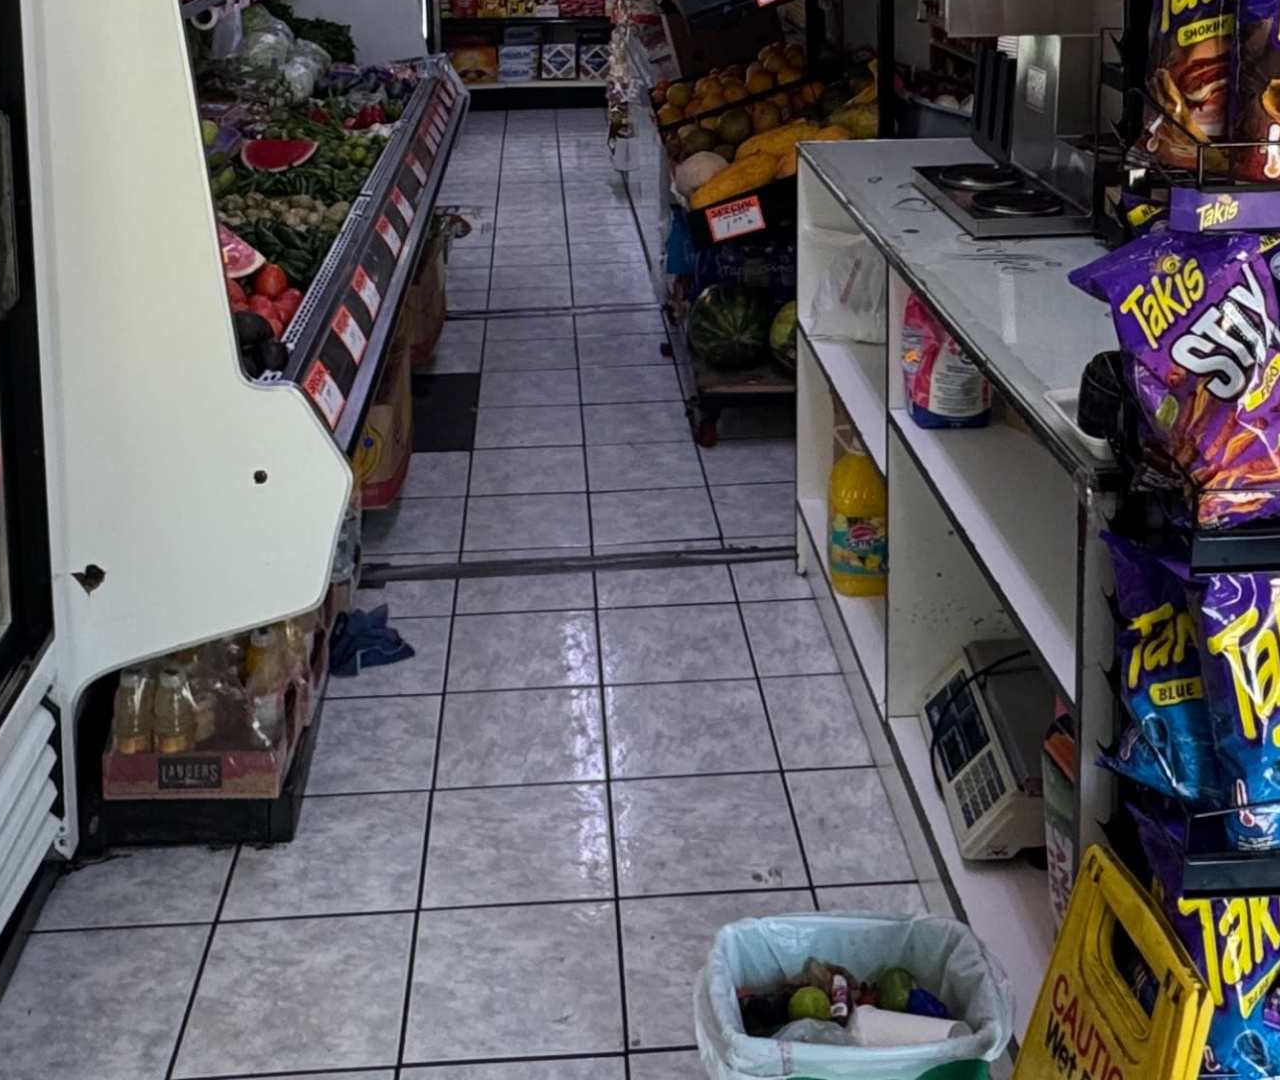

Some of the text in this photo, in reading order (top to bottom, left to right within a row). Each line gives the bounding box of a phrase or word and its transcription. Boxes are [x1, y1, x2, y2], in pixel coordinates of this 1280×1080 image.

[1196, 200, 1239, 229] Takis
[1120, 258, 1205, 349] Takis
[1158, 683, 1194, 701] BLUE
[1045, 1011, 1077, 1076] Wet
